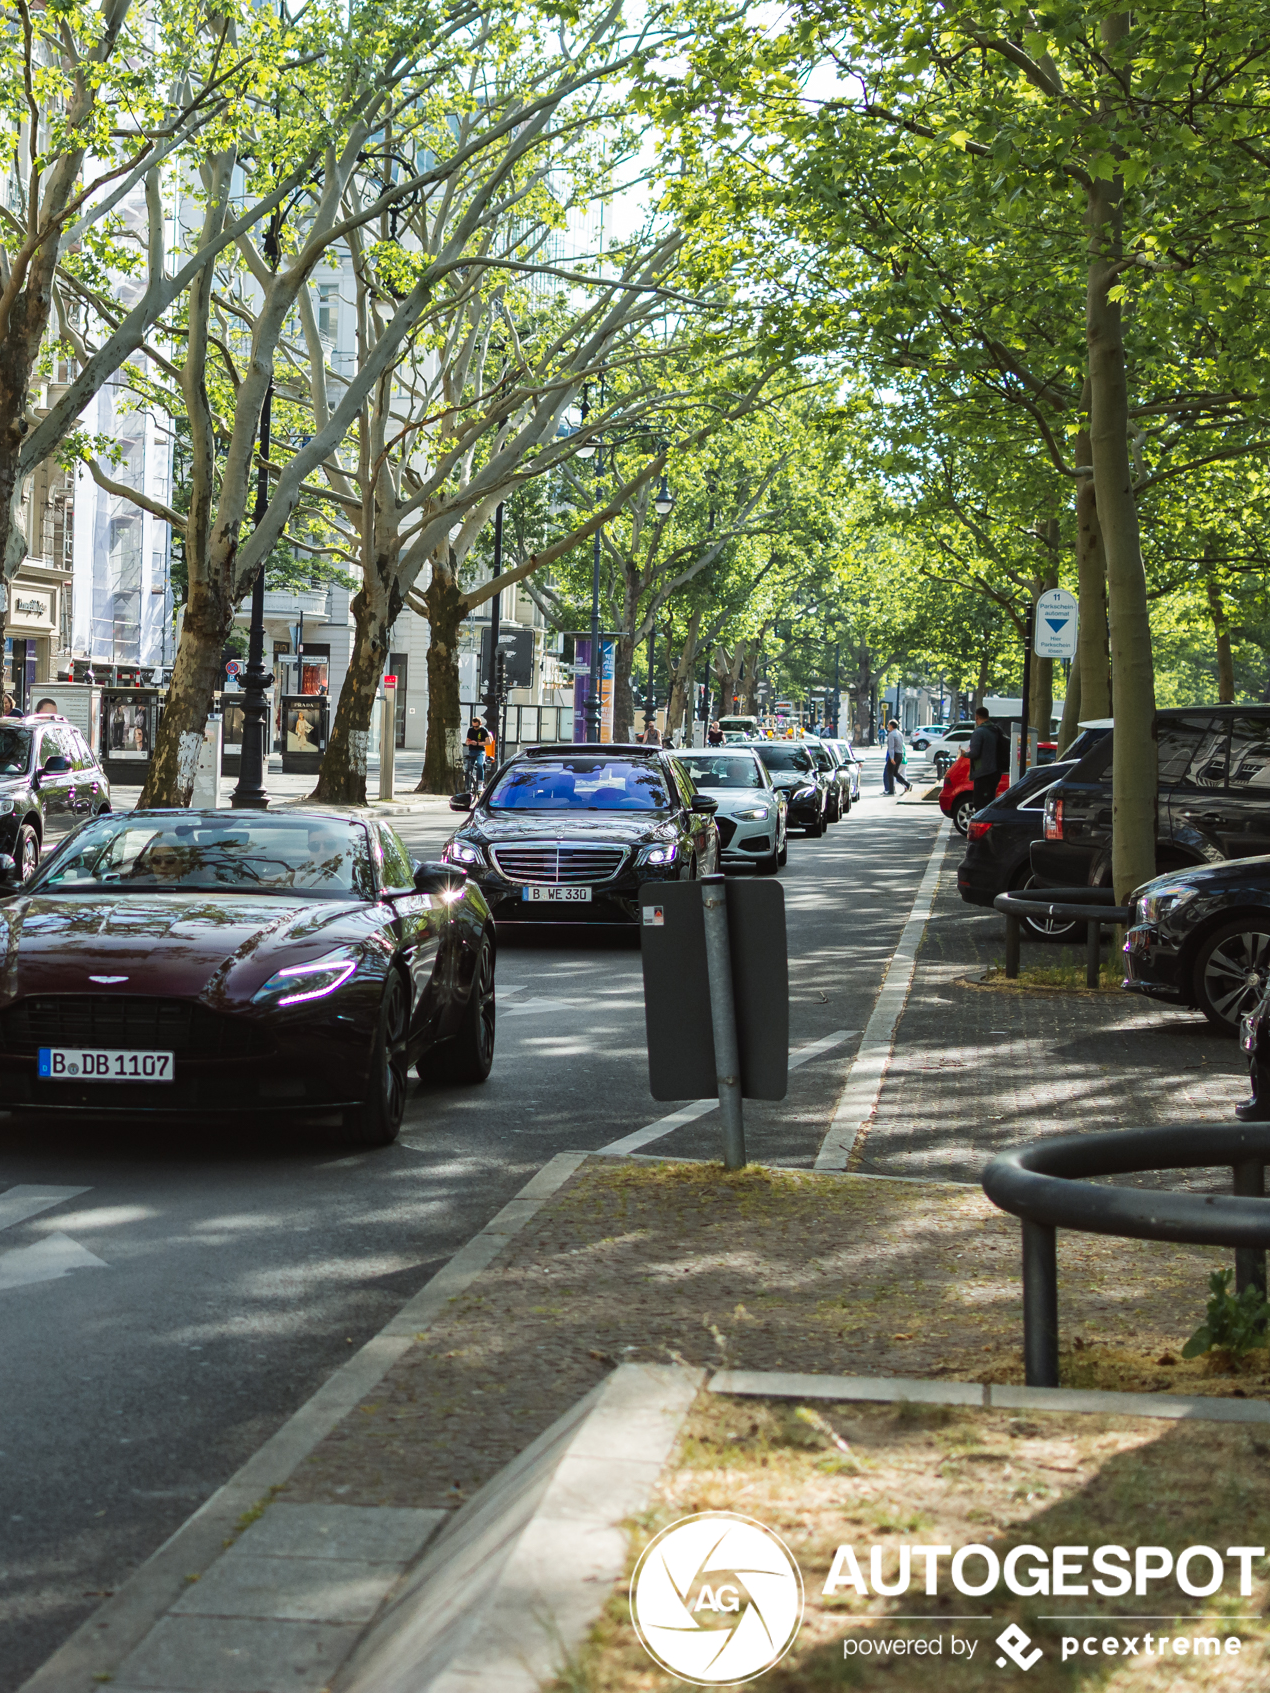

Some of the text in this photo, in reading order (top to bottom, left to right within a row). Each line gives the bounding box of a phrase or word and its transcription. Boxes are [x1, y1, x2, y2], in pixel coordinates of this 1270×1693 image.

[533, 888, 587, 900] B WE 330
[53, 1053, 66, 1074] B
[82, 1054, 109, 1075] DB
[115, 1055, 170, 1077] 1107
